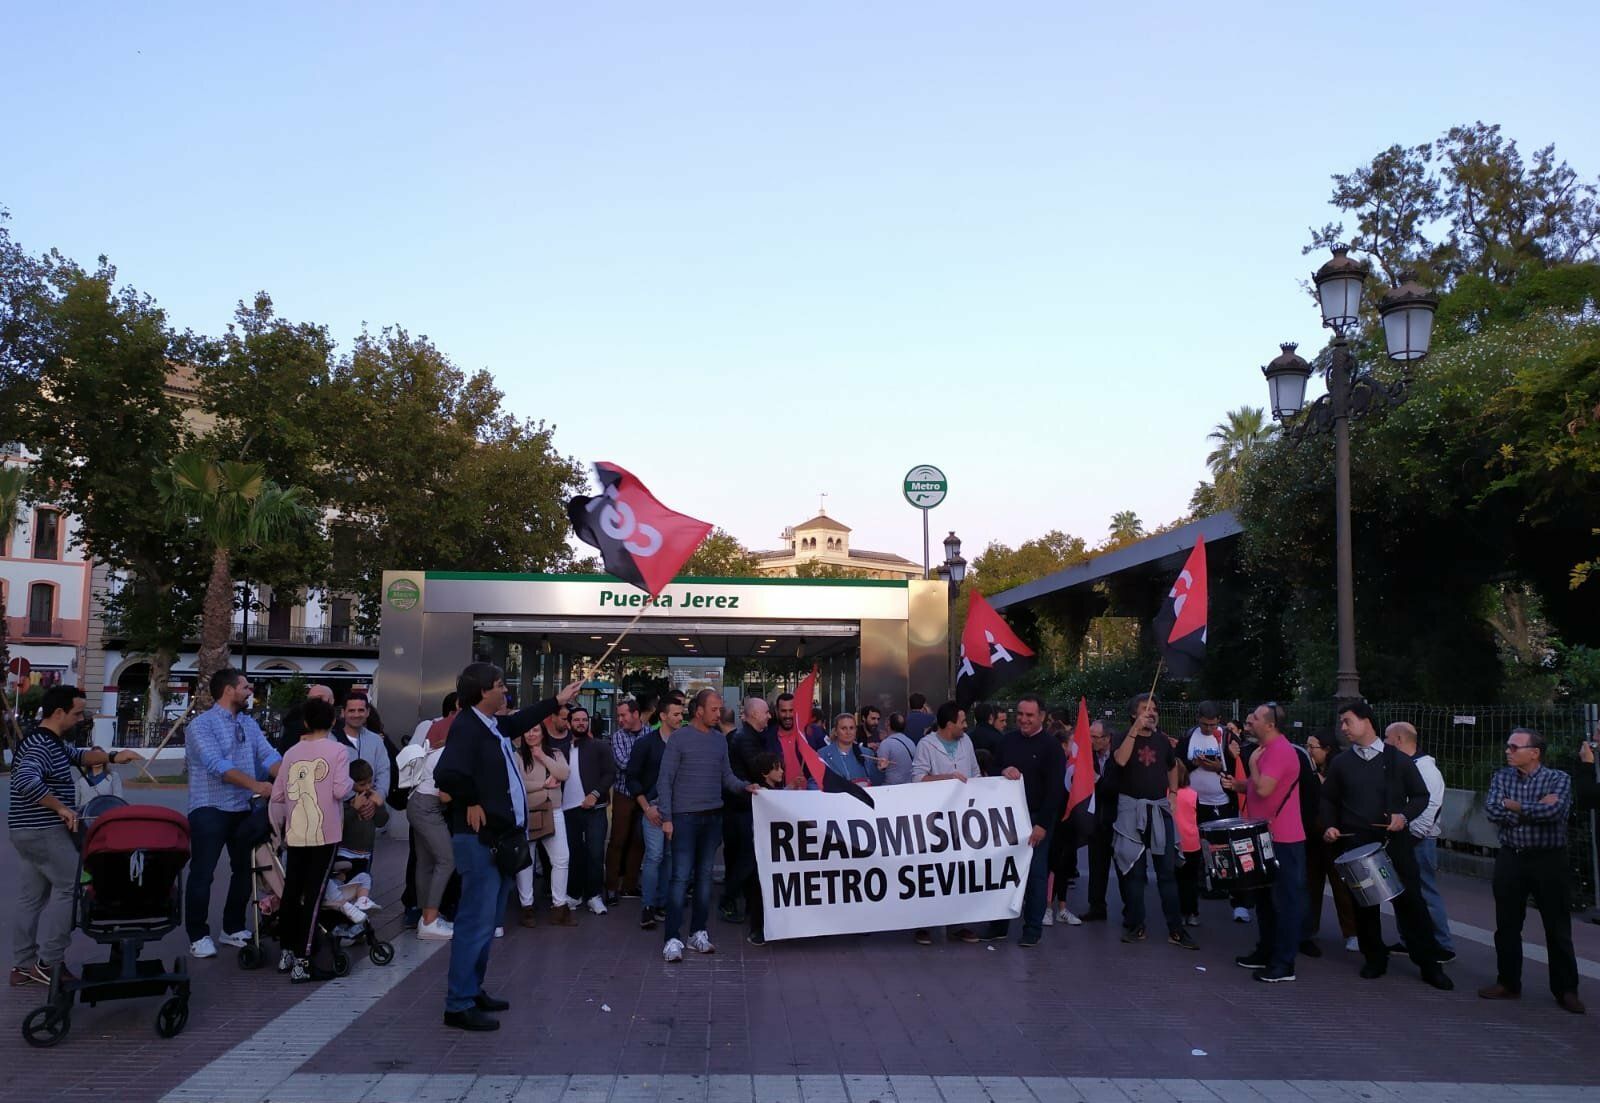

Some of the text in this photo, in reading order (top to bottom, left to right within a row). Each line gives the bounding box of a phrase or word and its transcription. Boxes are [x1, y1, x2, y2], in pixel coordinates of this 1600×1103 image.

[911, 482, 941, 491] Metro
[599, 590, 740, 609] Puerta Jerez
[770, 798, 1019, 863] READMISIÓN
[772, 856, 1021, 908] METRO SEVILLA
